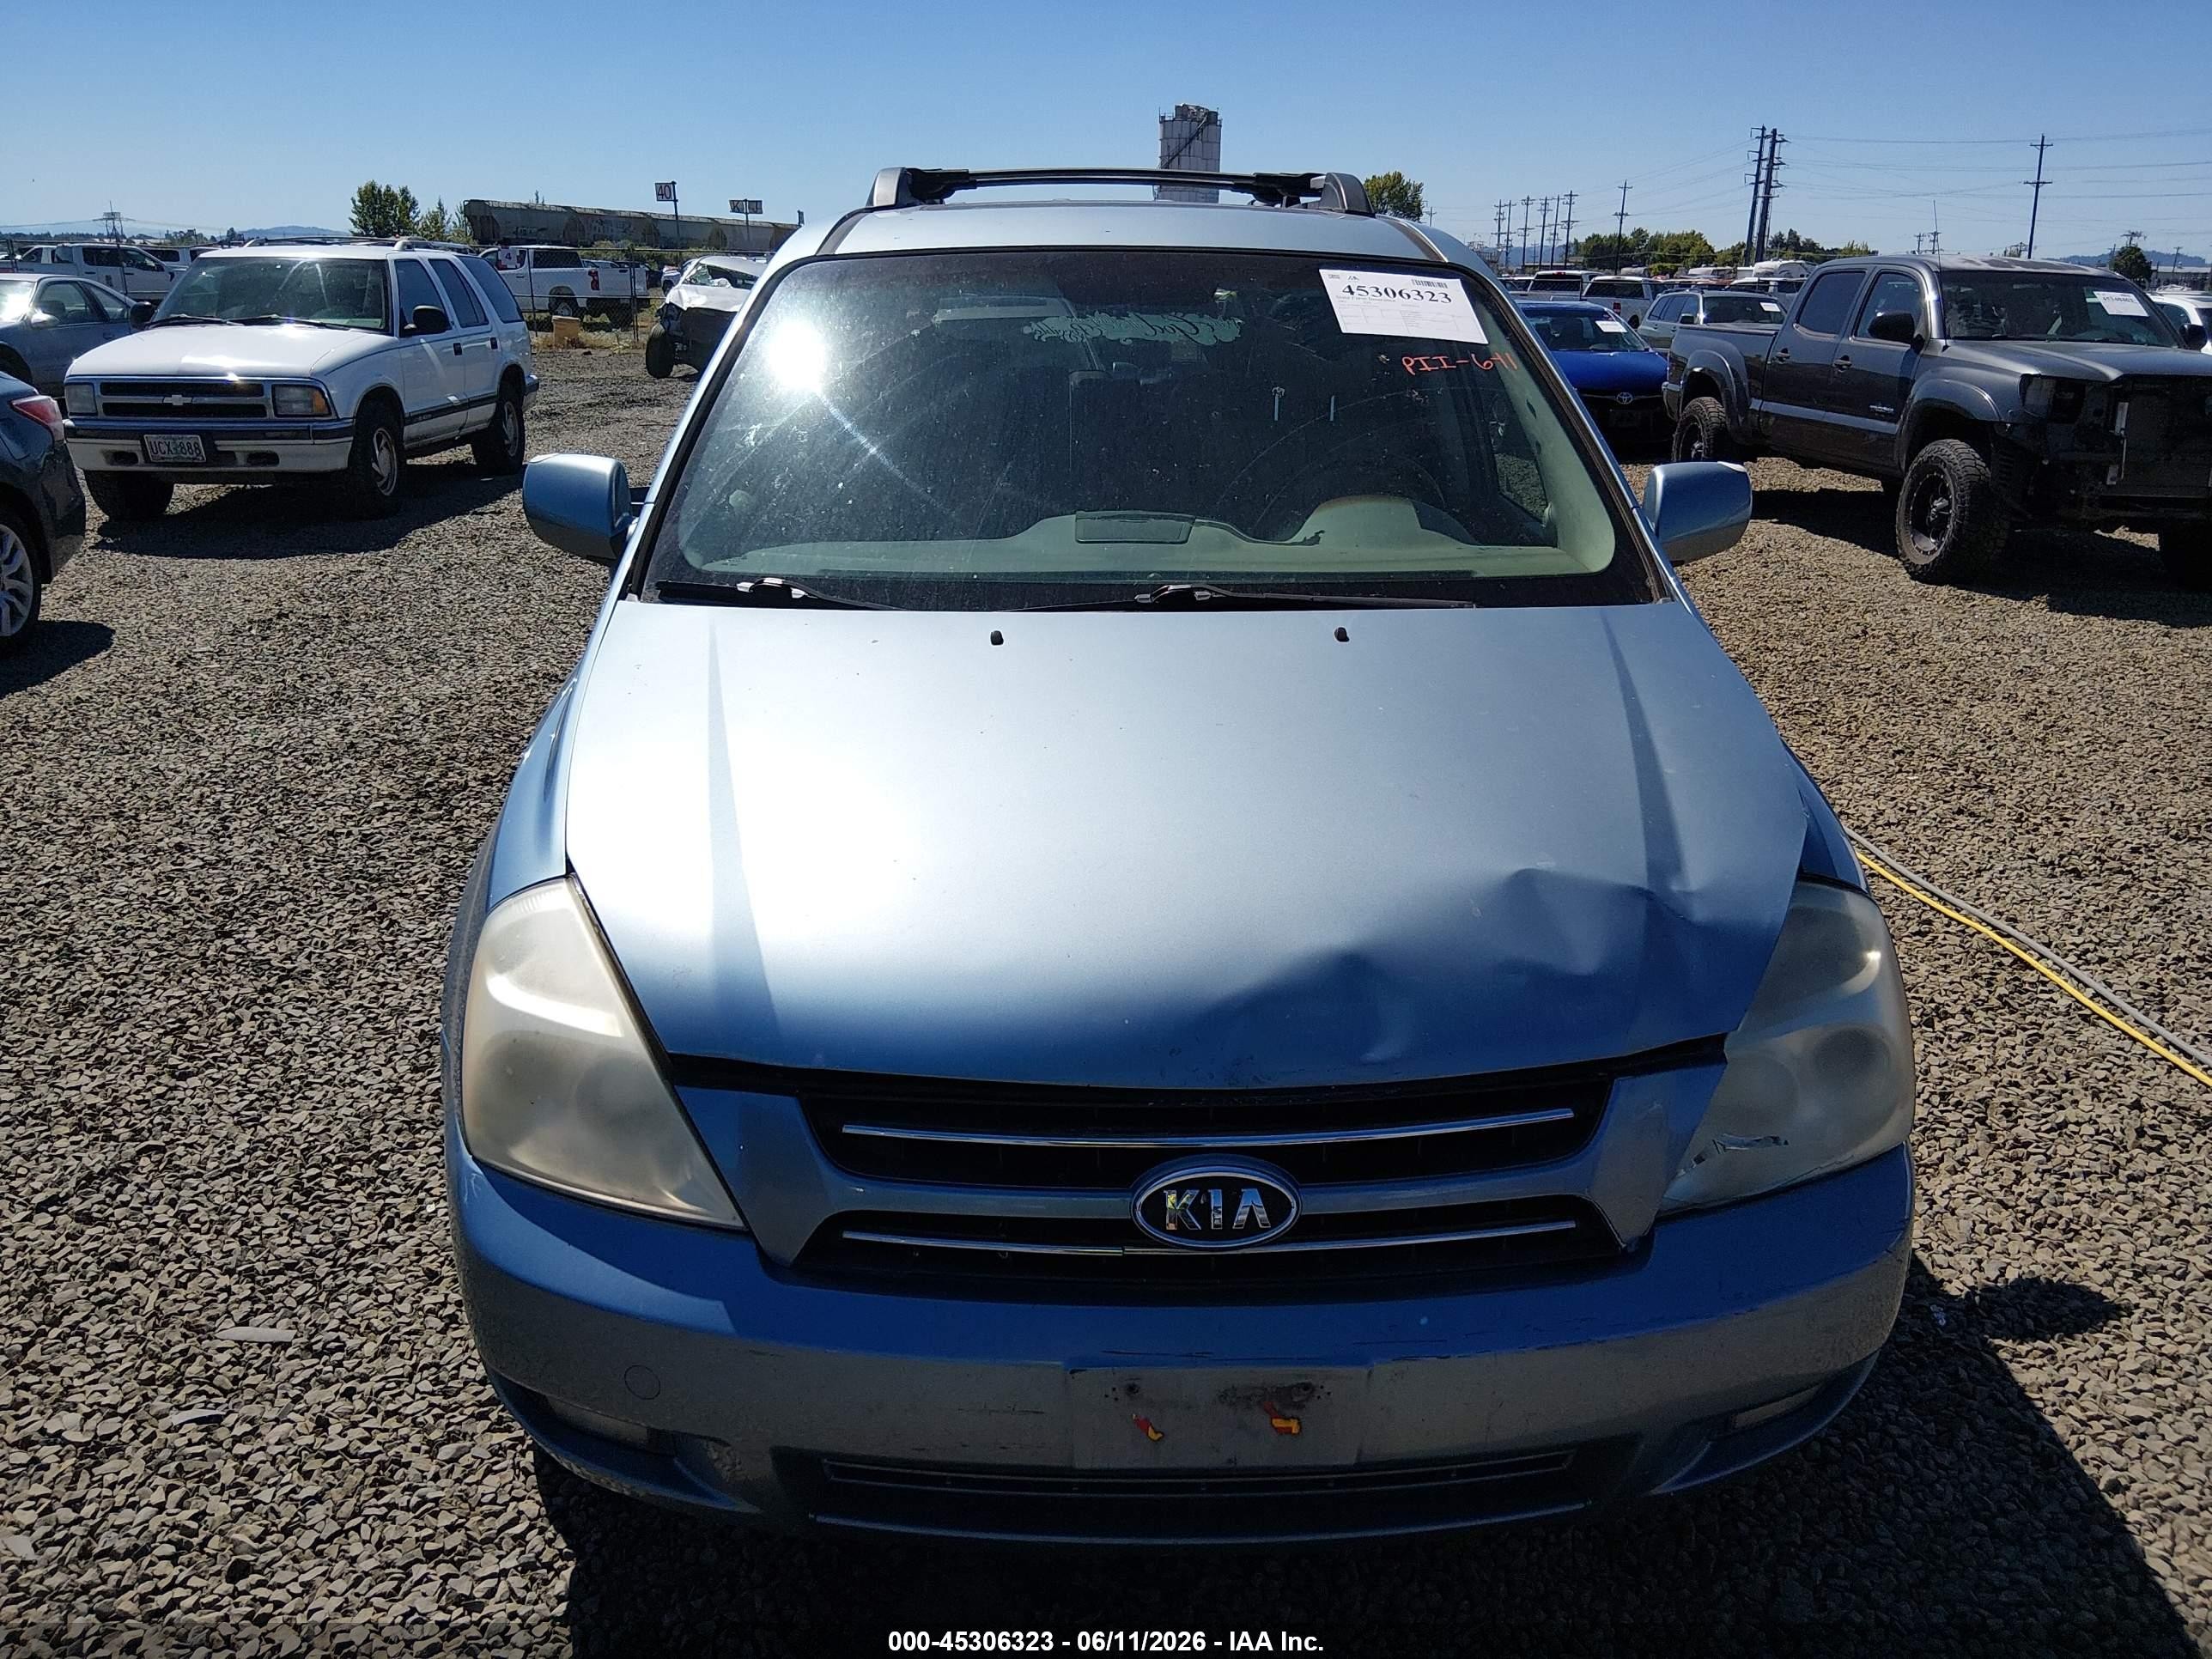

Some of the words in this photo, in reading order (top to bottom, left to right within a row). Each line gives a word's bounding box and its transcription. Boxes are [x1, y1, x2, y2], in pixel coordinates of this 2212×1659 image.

[657, 184, 672, 199] 40
[1342, 284, 1452, 304] 45306323
[149, 441, 173, 455] UCX
[179, 441, 202, 455] 888
[1163, 1188, 1272, 1231] KIA
